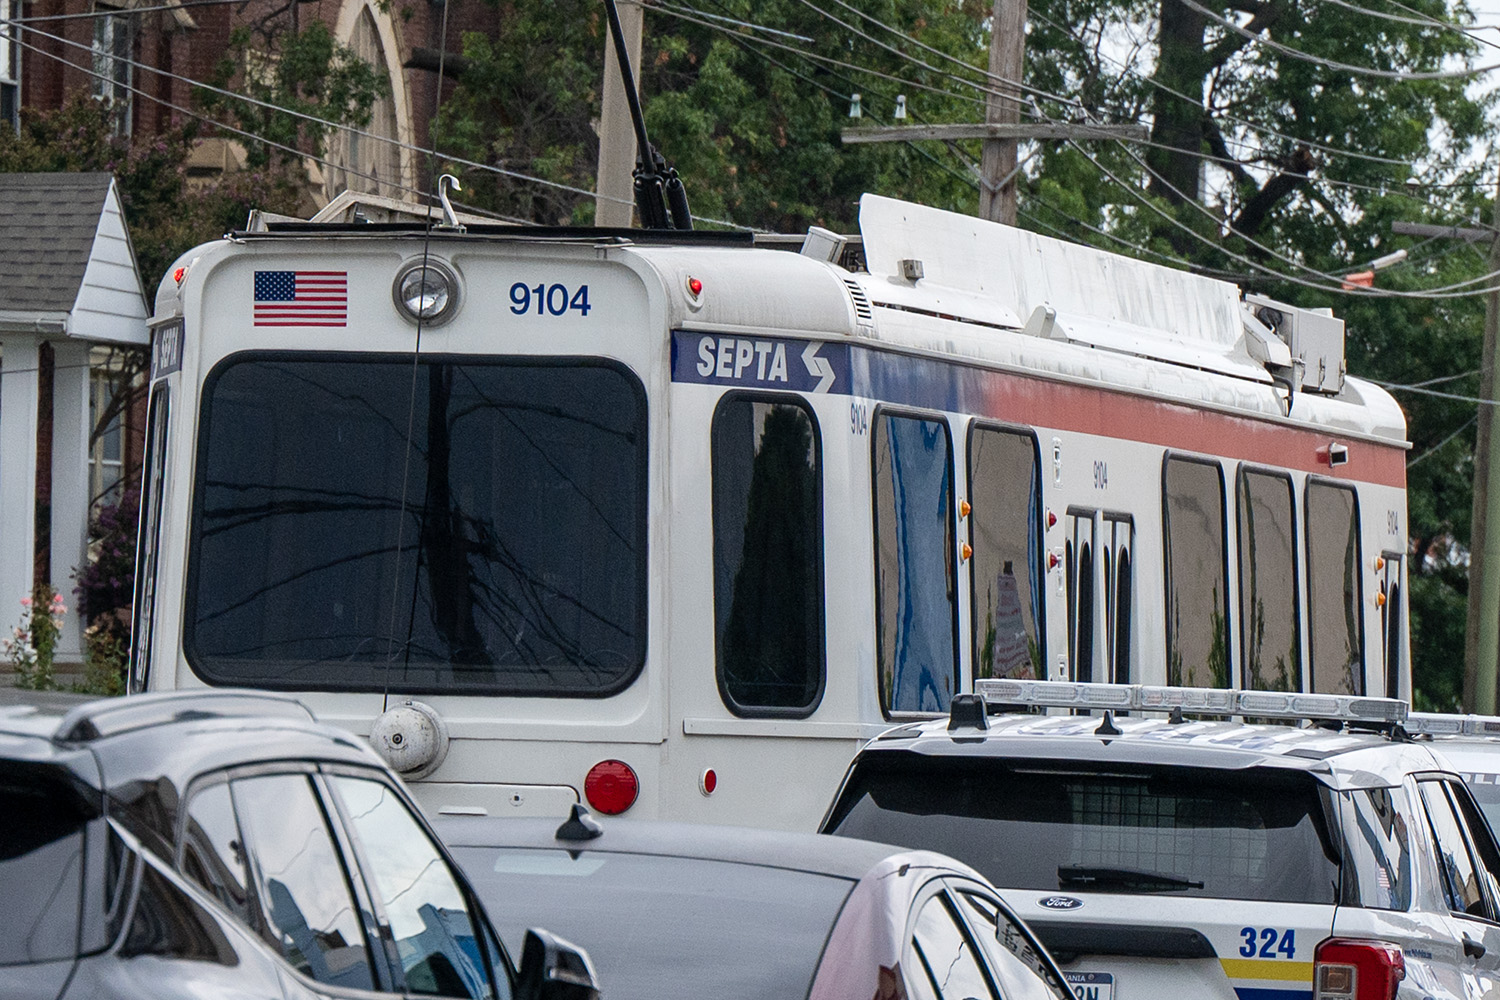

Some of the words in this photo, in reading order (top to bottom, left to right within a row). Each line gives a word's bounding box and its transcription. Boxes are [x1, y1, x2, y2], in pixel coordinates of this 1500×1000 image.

[509, 282, 592, 316] 9104
[696, 335, 788, 382] SEPTA
[851, 403, 868, 436] 9104
[1093, 460, 1108, 489] 9104
[1046, 897, 1073, 908] Ford
[1238, 926, 1296, 960] 324
